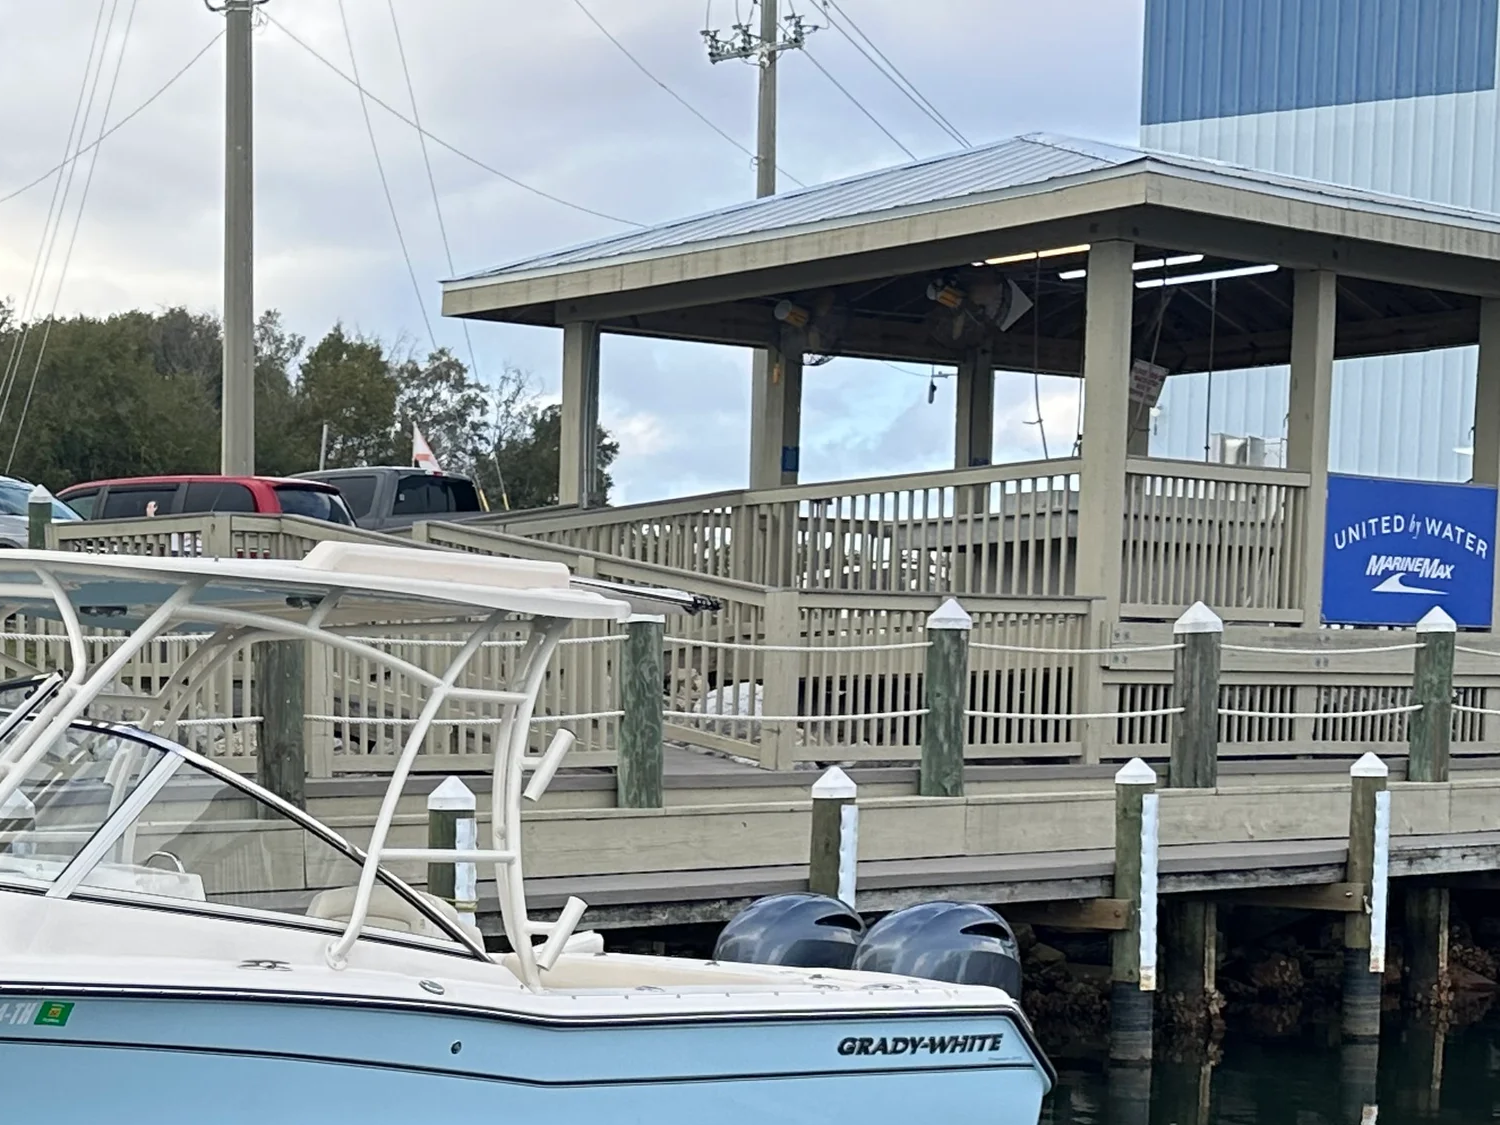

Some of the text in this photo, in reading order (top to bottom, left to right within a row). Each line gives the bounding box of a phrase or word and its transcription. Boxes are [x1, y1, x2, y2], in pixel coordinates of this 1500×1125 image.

[1334, 513, 1488, 560] UNITED by WATER
[1365, 554, 1455, 580] MARINEMAX
[837, 1033, 1003, 1056] GRADY-WHITE
